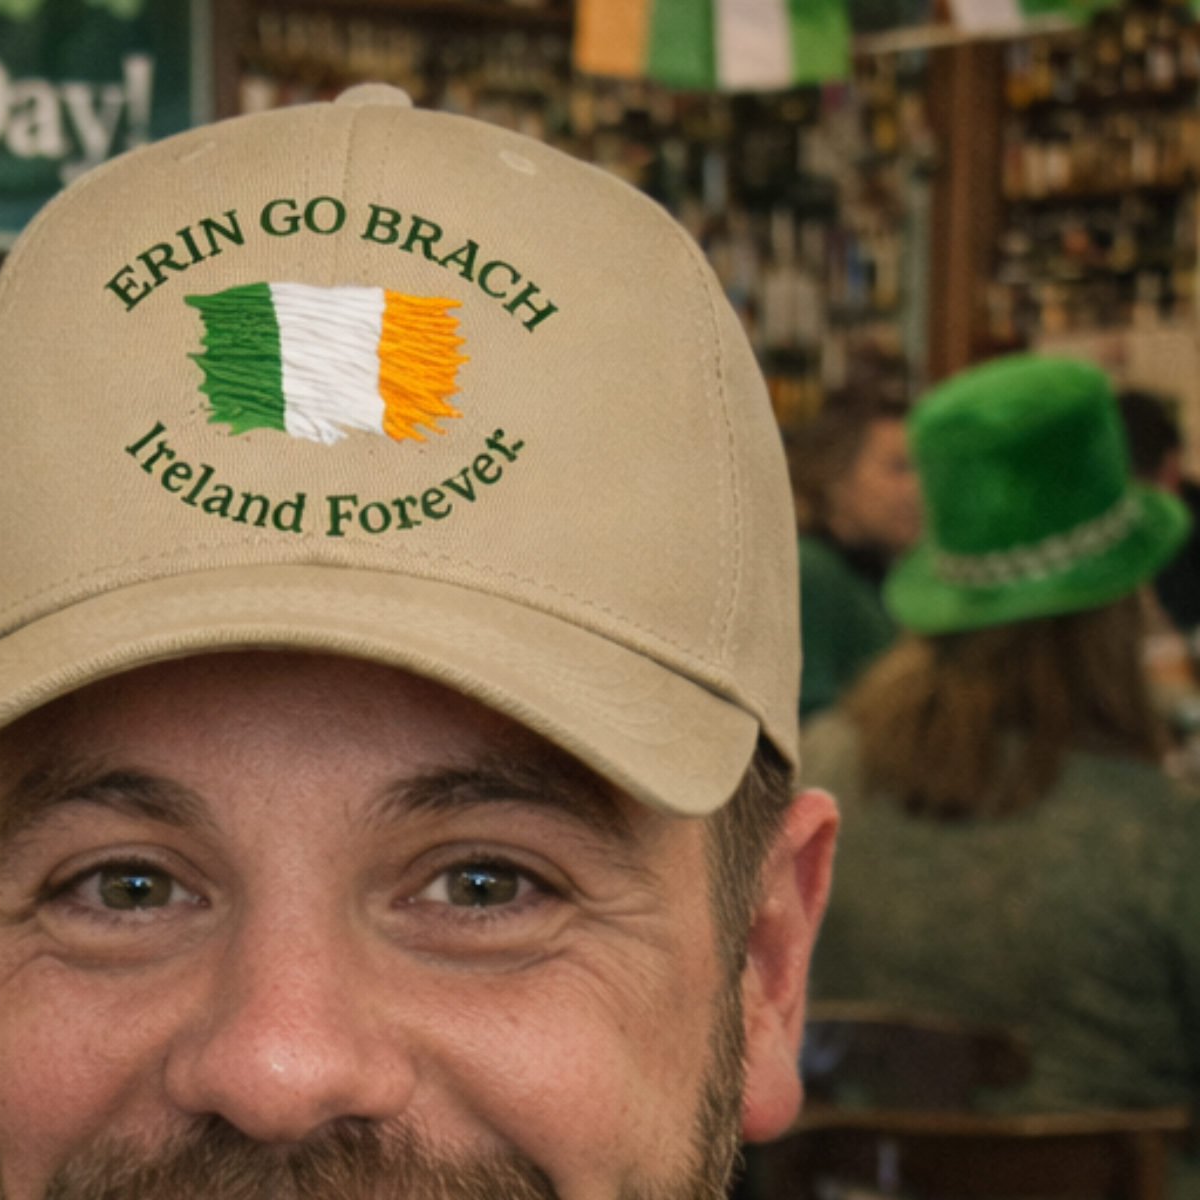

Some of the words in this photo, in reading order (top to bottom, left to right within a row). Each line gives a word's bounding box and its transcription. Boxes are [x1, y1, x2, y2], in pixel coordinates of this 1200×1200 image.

[103, 207, 247, 313] ERIN
[258, 195, 348, 237] GO
[359, 203, 559, 334] BRACH
[123, 420, 307, 534] Ireland
